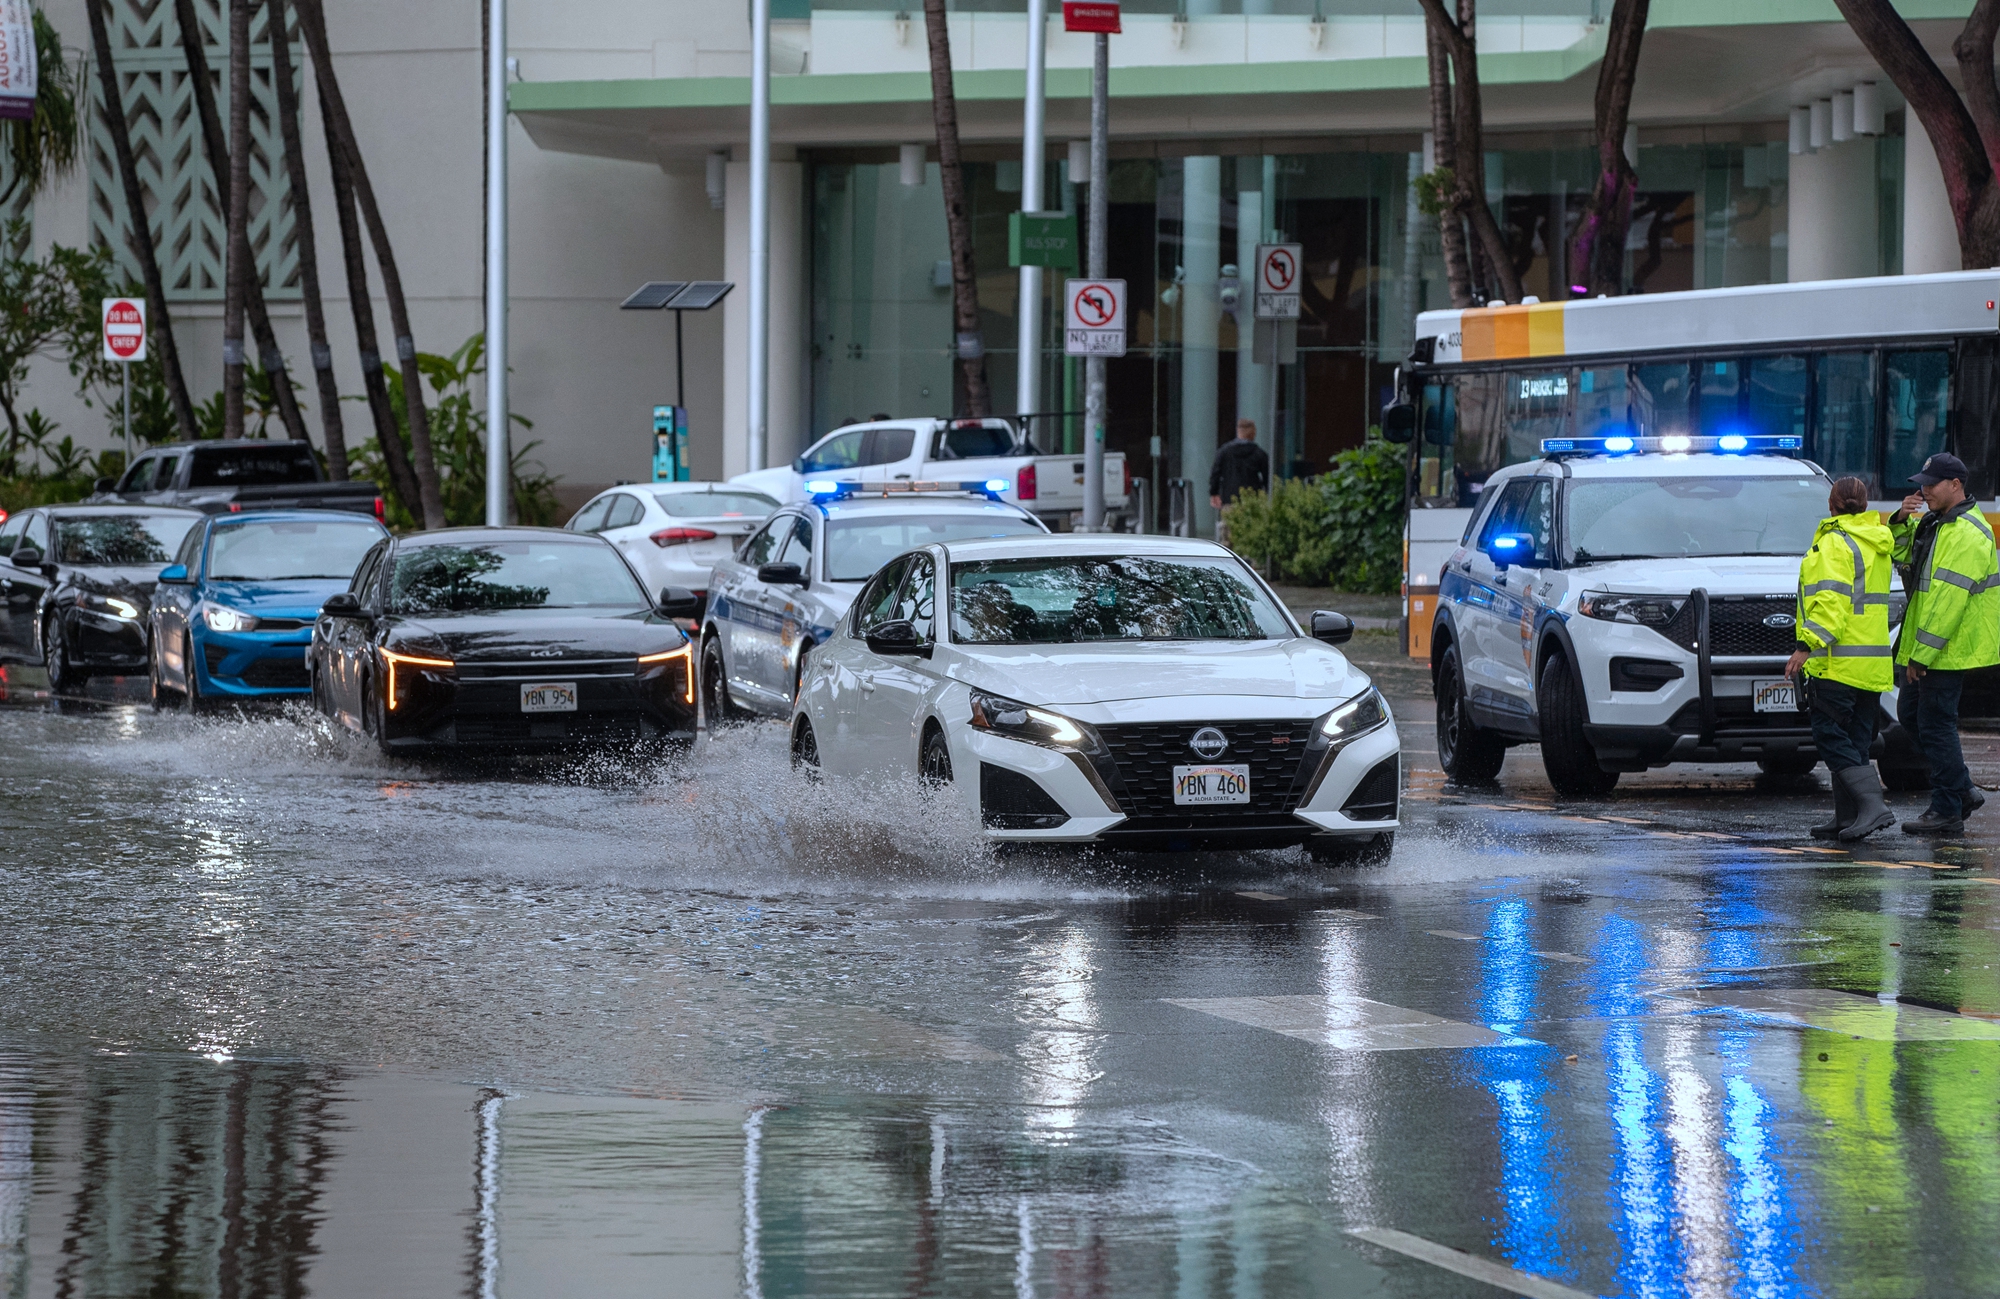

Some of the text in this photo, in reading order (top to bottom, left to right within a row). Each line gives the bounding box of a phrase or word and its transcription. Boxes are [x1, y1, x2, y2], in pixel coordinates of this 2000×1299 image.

[0, 21, 10, 89] AUGUS
[1025, 237, 1068, 249] BUS STOP
[109, 310, 139, 322] DO NOT
[112, 336, 137, 349] ENTER
[1070, 330, 1120, 343] NO LEFT
[1771, 616, 1790, 625] Ford
[523, 689, 574, 706] YBN 954
[1756, 687, 1794, 705] HPD21
[1189, 739, 1229, 748] NISSAN
[1177, 774, 1246, 796] YBN 460
